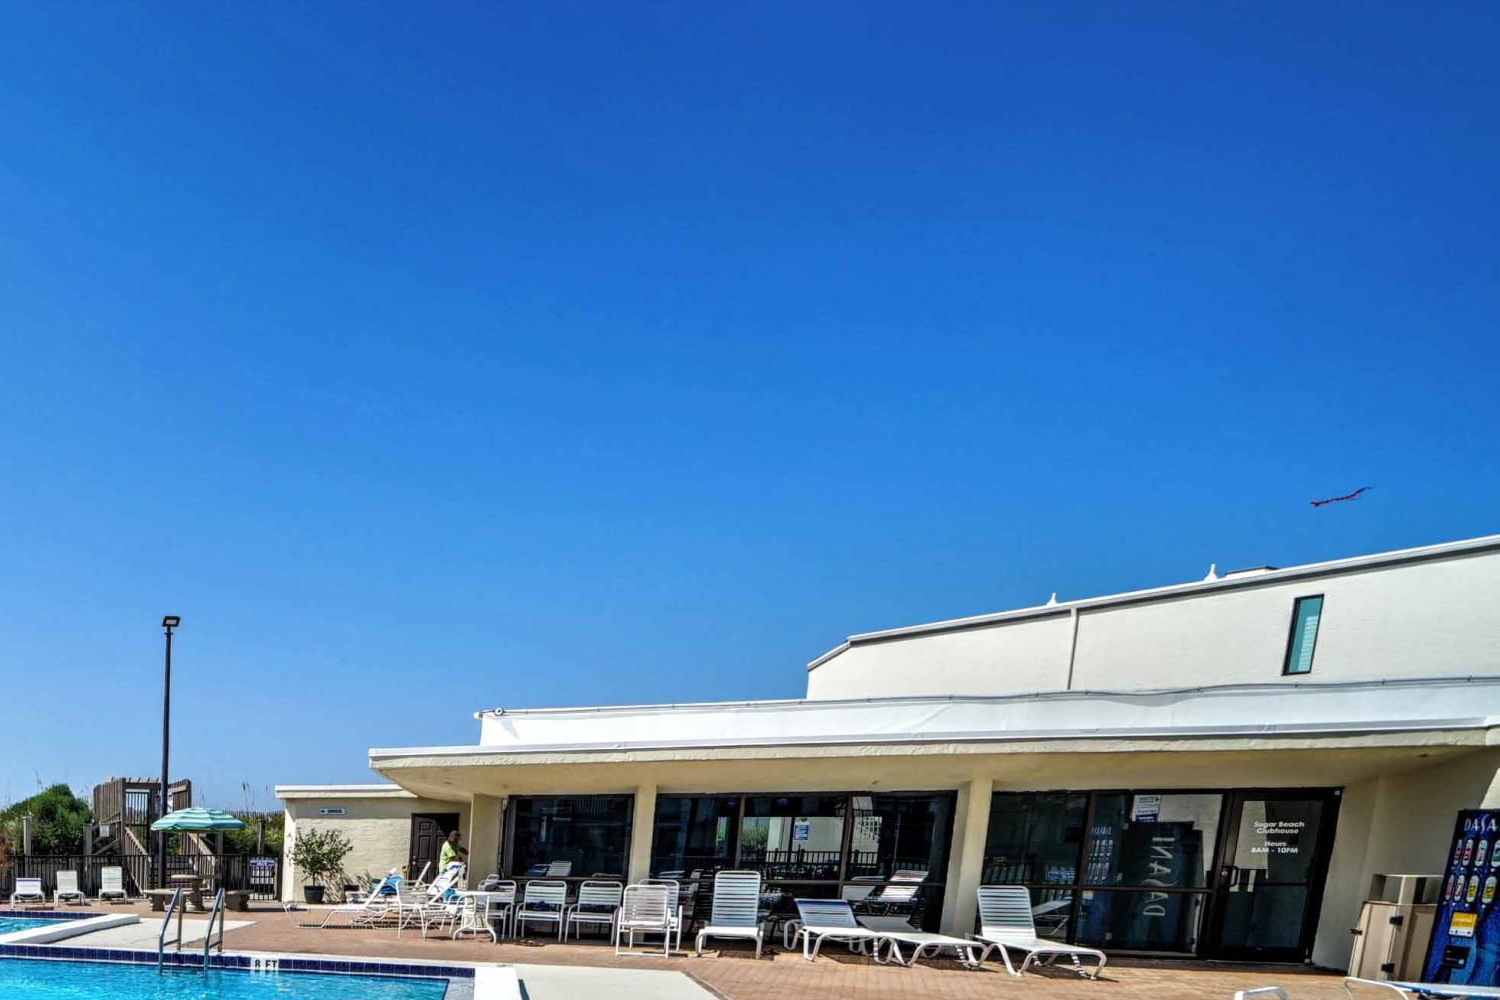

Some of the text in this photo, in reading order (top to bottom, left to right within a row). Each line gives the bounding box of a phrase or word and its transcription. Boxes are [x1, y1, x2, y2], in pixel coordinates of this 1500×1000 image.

[1253, 821, 1278, 829] Sugar
[1464, 814, 1500, 834] DASA
[265, 959, 278, 968] FT
